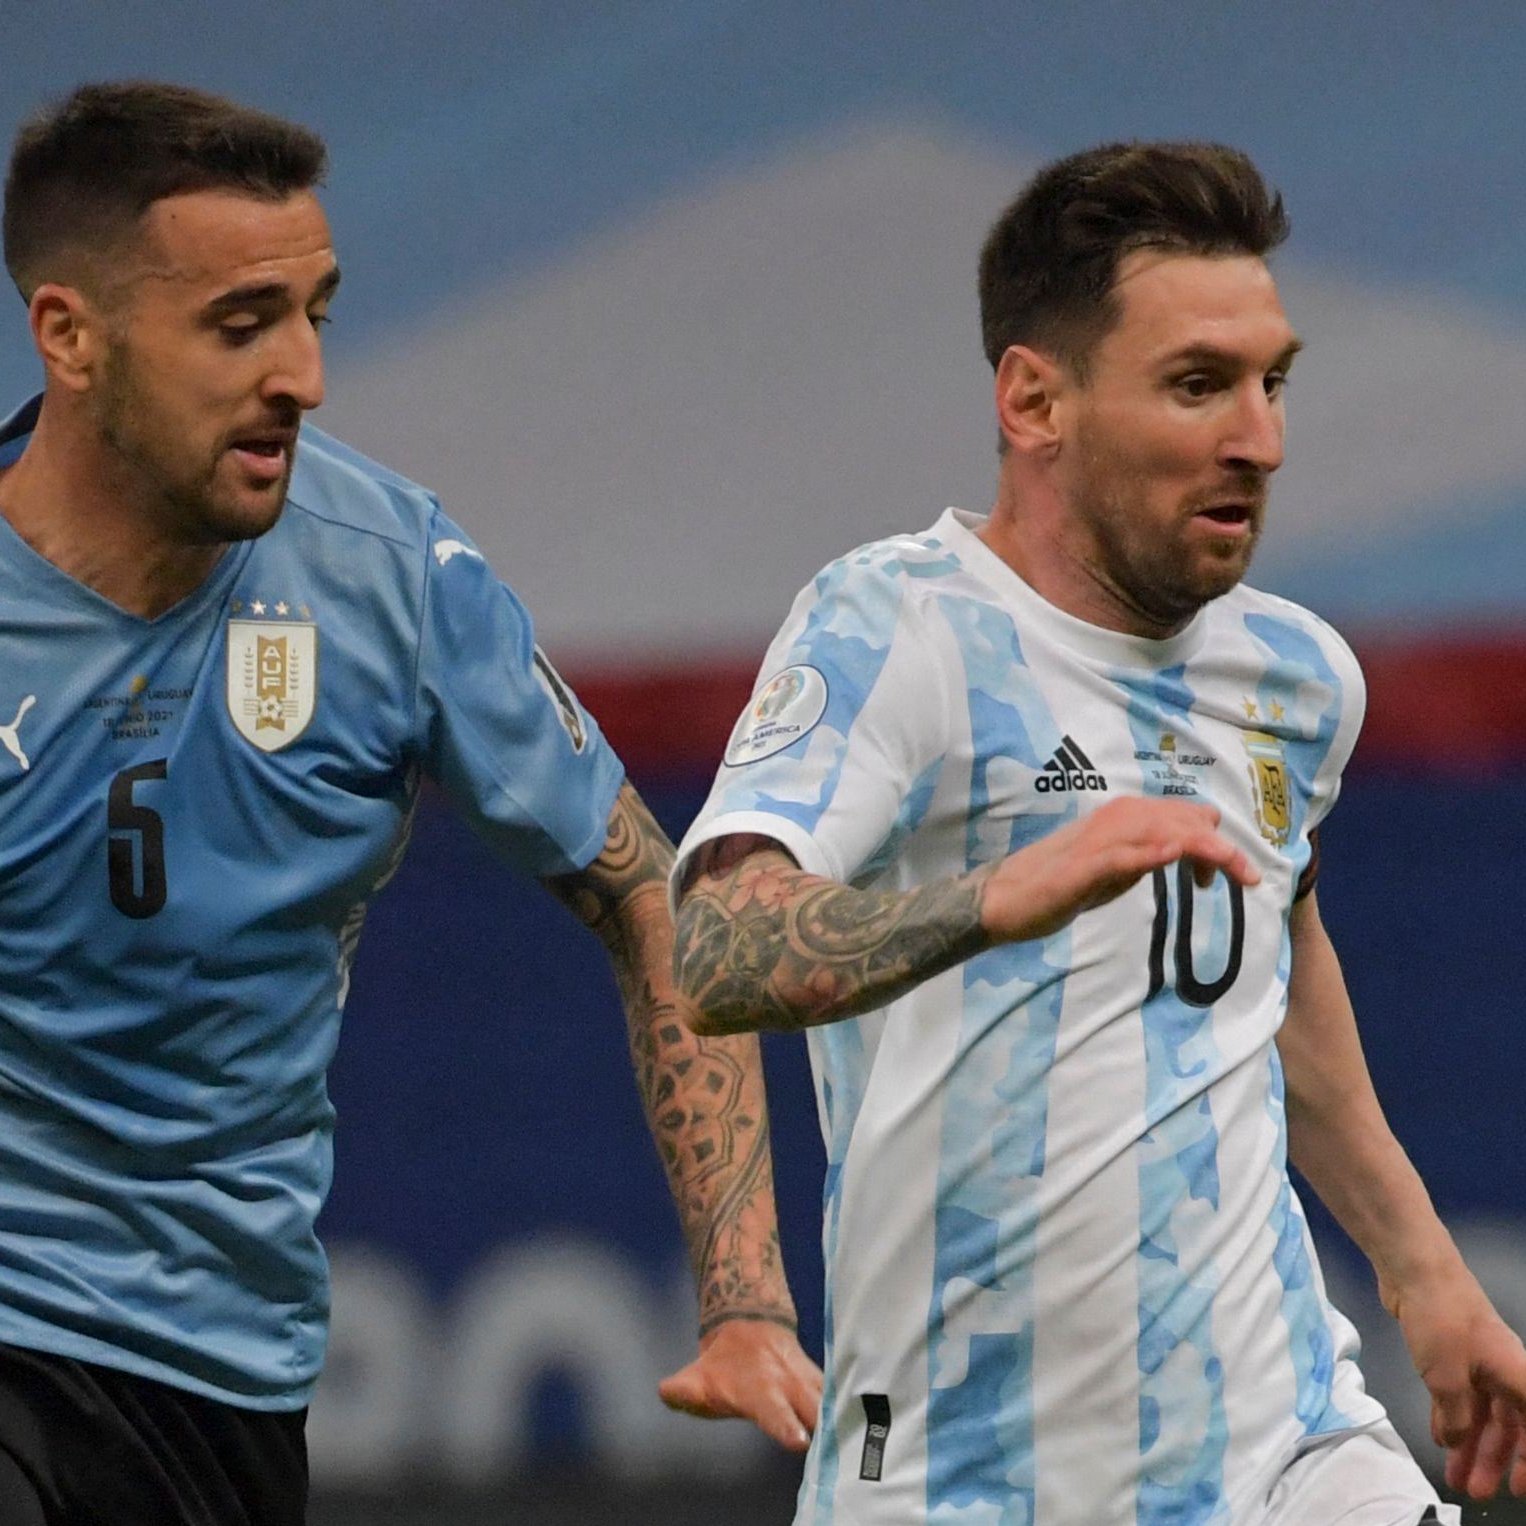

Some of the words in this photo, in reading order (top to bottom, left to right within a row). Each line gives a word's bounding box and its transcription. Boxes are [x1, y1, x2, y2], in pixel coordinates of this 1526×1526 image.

[262, 646, 282, 690] AUF
[1034, 769, 1108, 793] adidas
[107, 758, 168, 920] 5
[1145, 856, 1245, 1009] 10
